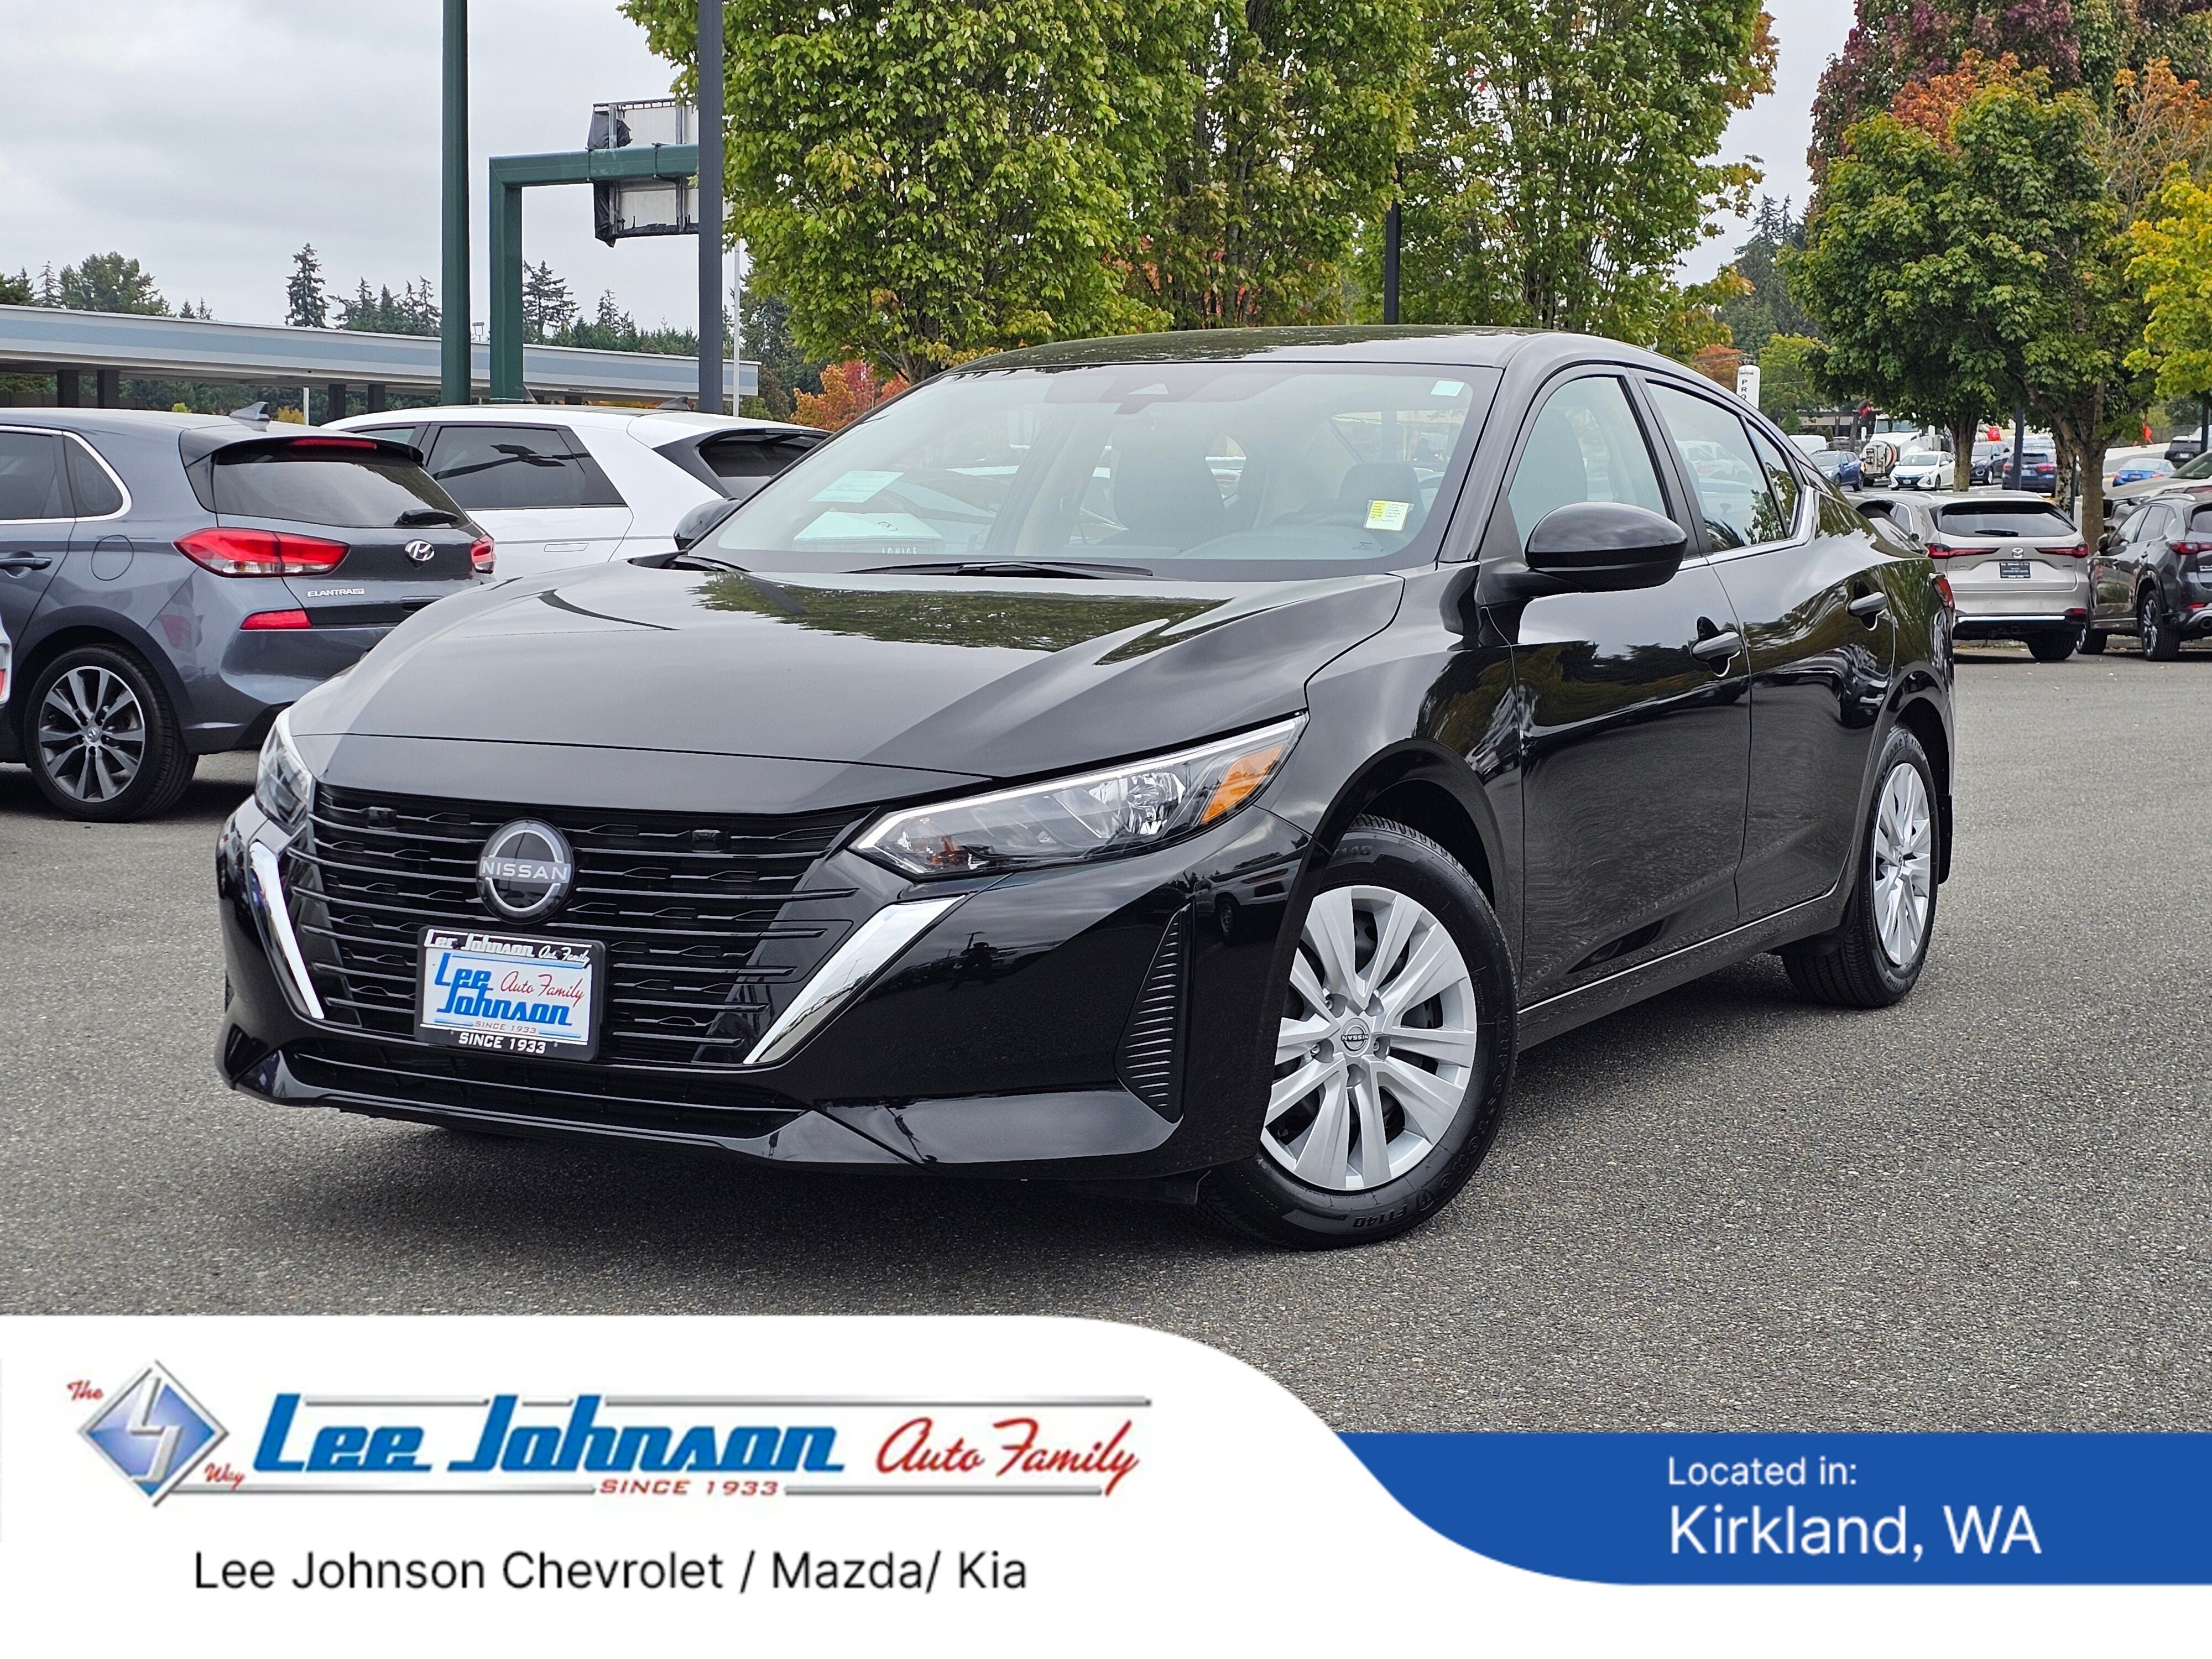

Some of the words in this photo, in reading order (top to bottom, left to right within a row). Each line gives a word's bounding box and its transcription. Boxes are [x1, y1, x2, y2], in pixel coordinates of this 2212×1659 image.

[307, 588, 353, 597] ELANTRA
[482, 860, 568, 881] NISSAN
[424, 928, 459, 950] Lee
[460, 933, 535, 958] Johnson
[538, 945, 563, 960] Aut
[434, 952, 494, 990] Lee
[500, 971, 535, 994] Auto
[538, 974, 585, 1008] Family
[436, 985, 572, 1026] Johnson
[474, 1020, 507, 1031] SINCE
[510, 1024, 538, 1035] 1933
[458, 1032, 504, 1050] SINCE
[509, 1036, 546, 1054] 1933
[1352, 1203, 1407, 1228] FT140
